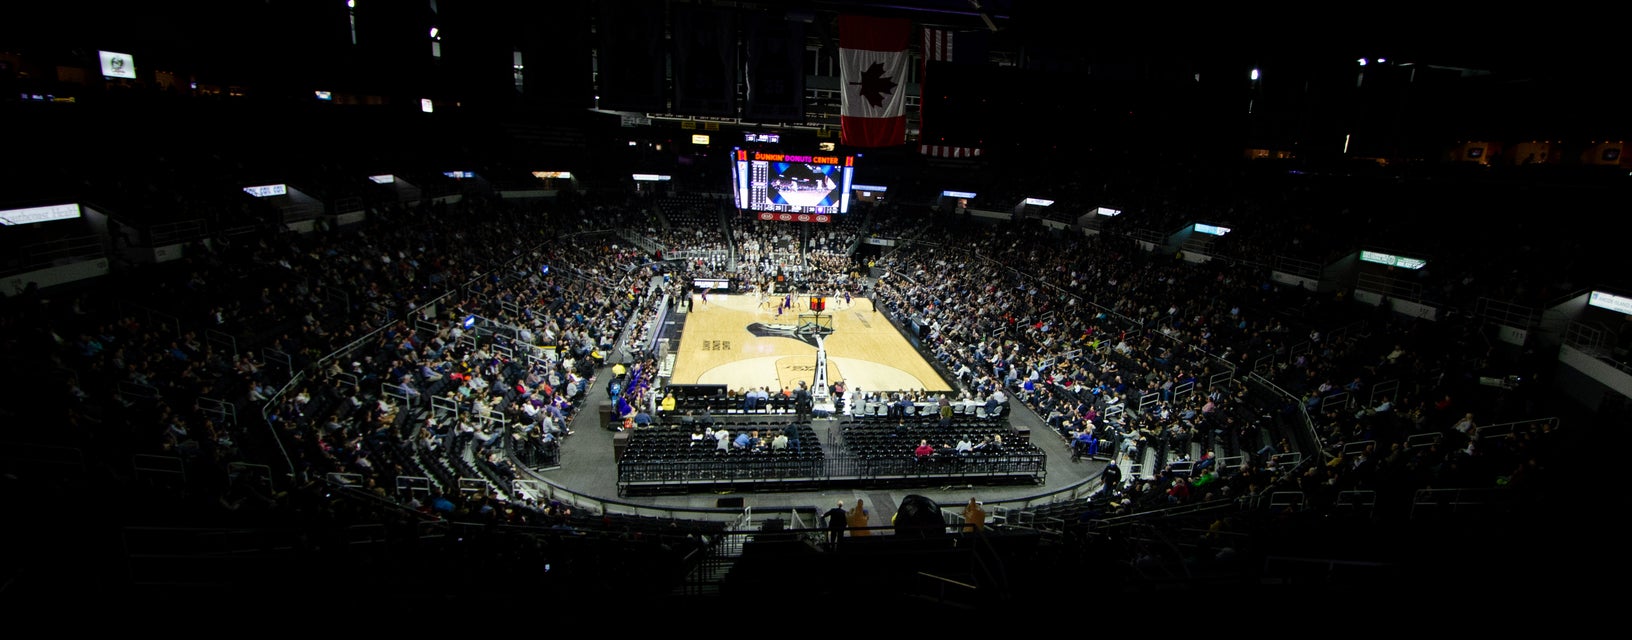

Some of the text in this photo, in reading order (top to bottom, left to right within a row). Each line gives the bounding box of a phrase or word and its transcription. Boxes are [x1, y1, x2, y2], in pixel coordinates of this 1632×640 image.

[755, 153, 839, 164] DUNKIN' DONUTS CENTER
